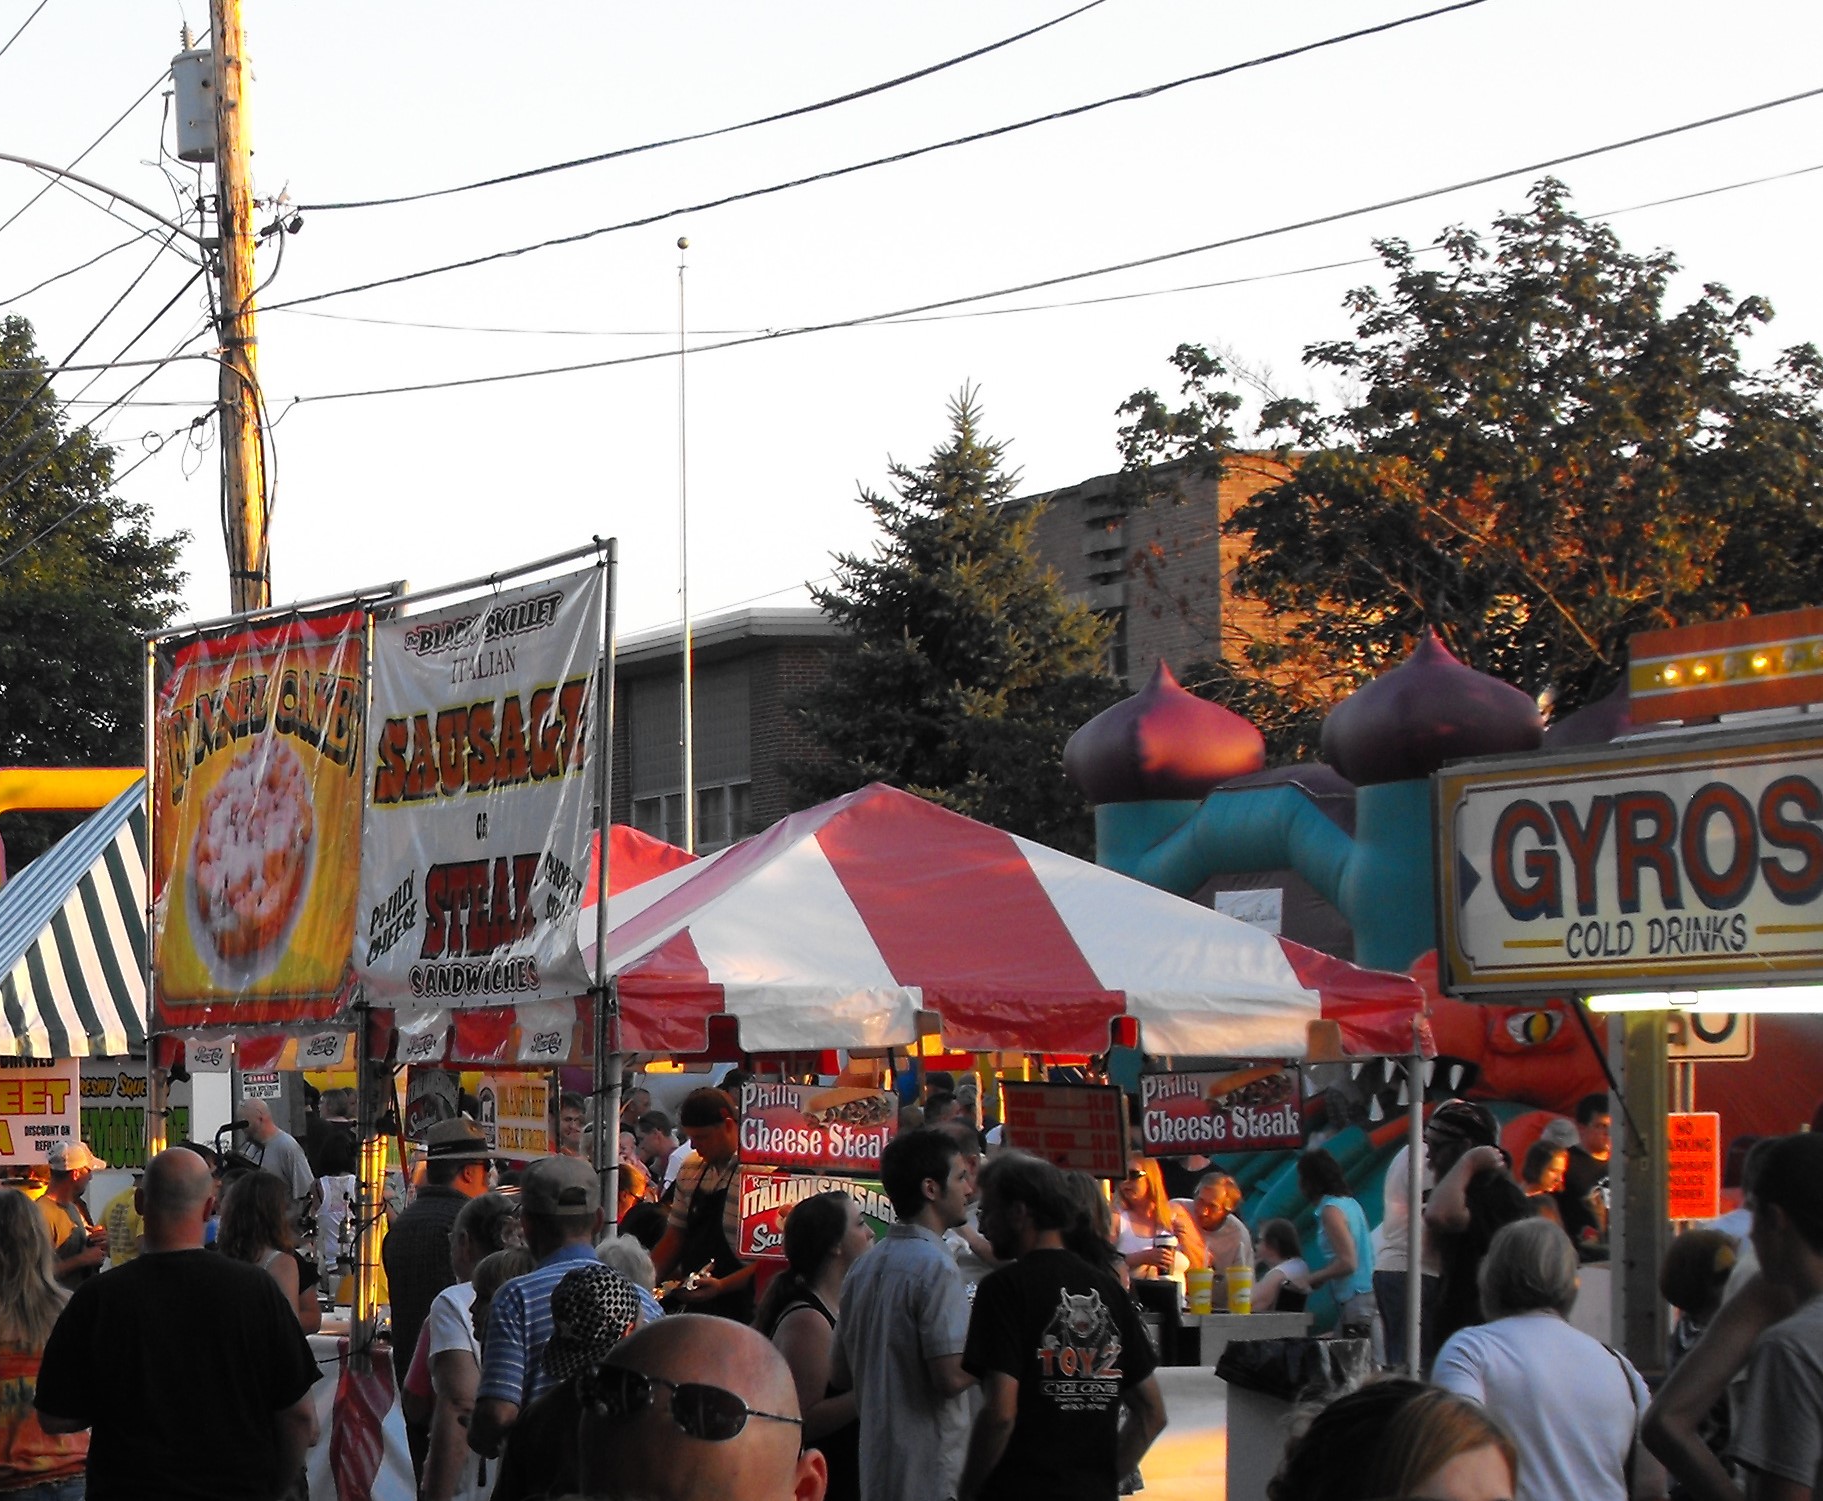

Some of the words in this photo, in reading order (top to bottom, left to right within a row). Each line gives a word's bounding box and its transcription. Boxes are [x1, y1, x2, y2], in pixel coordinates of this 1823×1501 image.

[417, 616, 480, 656] BLACK
[484, 591, 564, 642] SKILLET
[451, 646, 517, 684] ITALIAN
[476, 812, 488, 840] OR
[1491, 775, 1823, 922] GYROS
[370, 870, 414, 937] PHILLY
[1566, 917, 1634, 959] COLD
[1647, 913, 1748, 955] DRINKS
[408, 956, 541, 998] SANDWICHES
[79, 1076, 117, 1098] RESHLY
[742, 1082, 800, 1115] Philly
[1142, 1075, 1200, 1108] Philly
[740, 1117, 822, 1156] Cheese
[1143, 1110, 1226, 1143] Cheese
[1231, 1103, 1300, 1139] Steak
[742, 1178, 812, 1218] ITALIAN
[1670, 1175, 1705, 1186] OLICE
